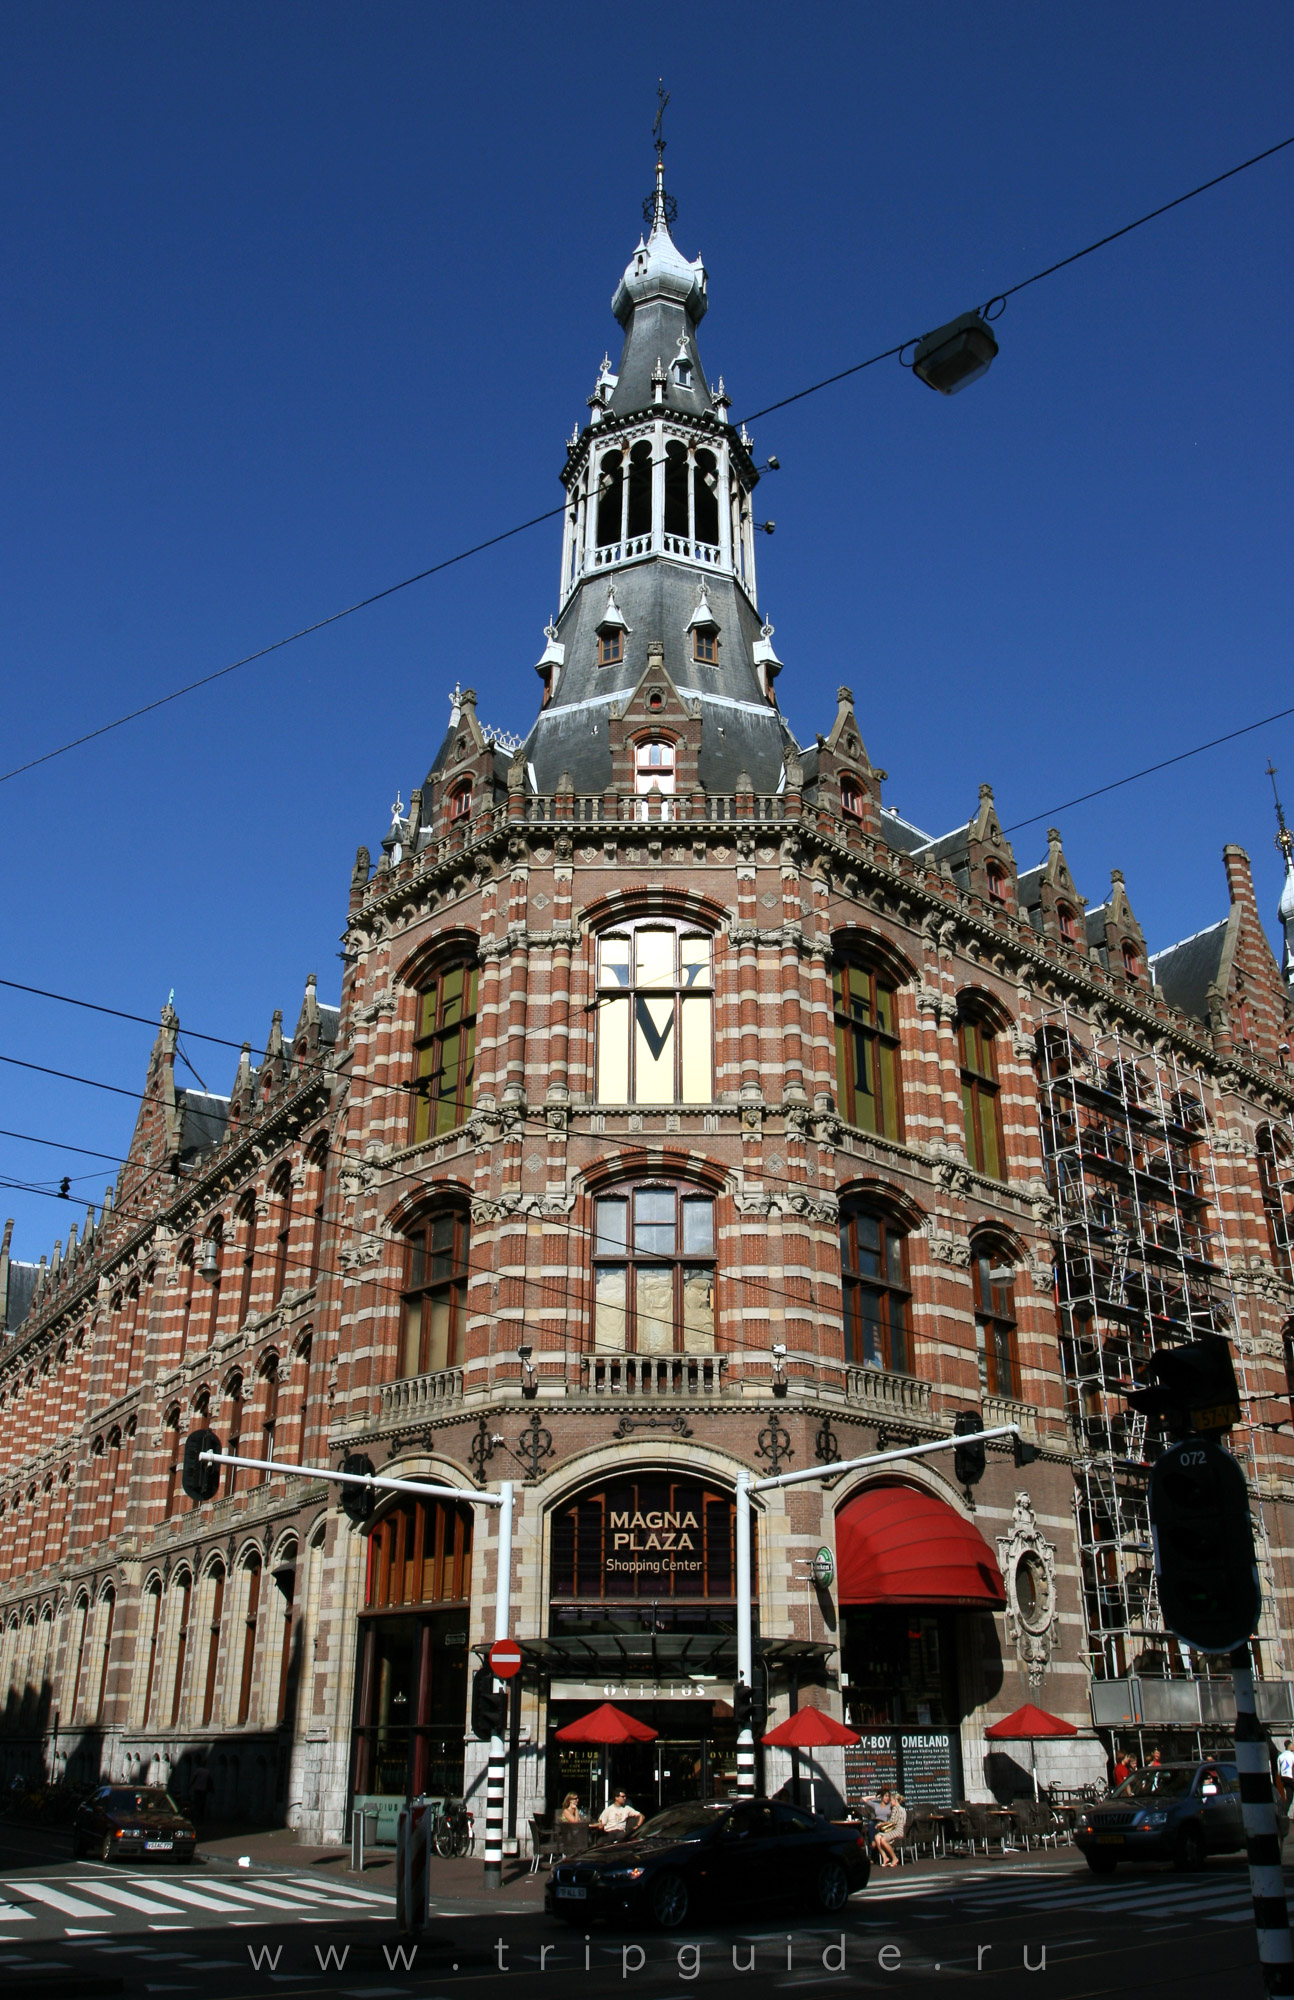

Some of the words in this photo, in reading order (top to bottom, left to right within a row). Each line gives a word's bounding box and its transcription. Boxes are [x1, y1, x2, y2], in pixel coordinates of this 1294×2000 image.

[1179, 1450, 1208, 1467] 072
[610, 1511, 699, 1529] MAGNA
[613, 1532, 695, 1551] PLAZA
[606, 1558, 660, 1573] Shopping
[662, 1558, 703, 1571] Center
